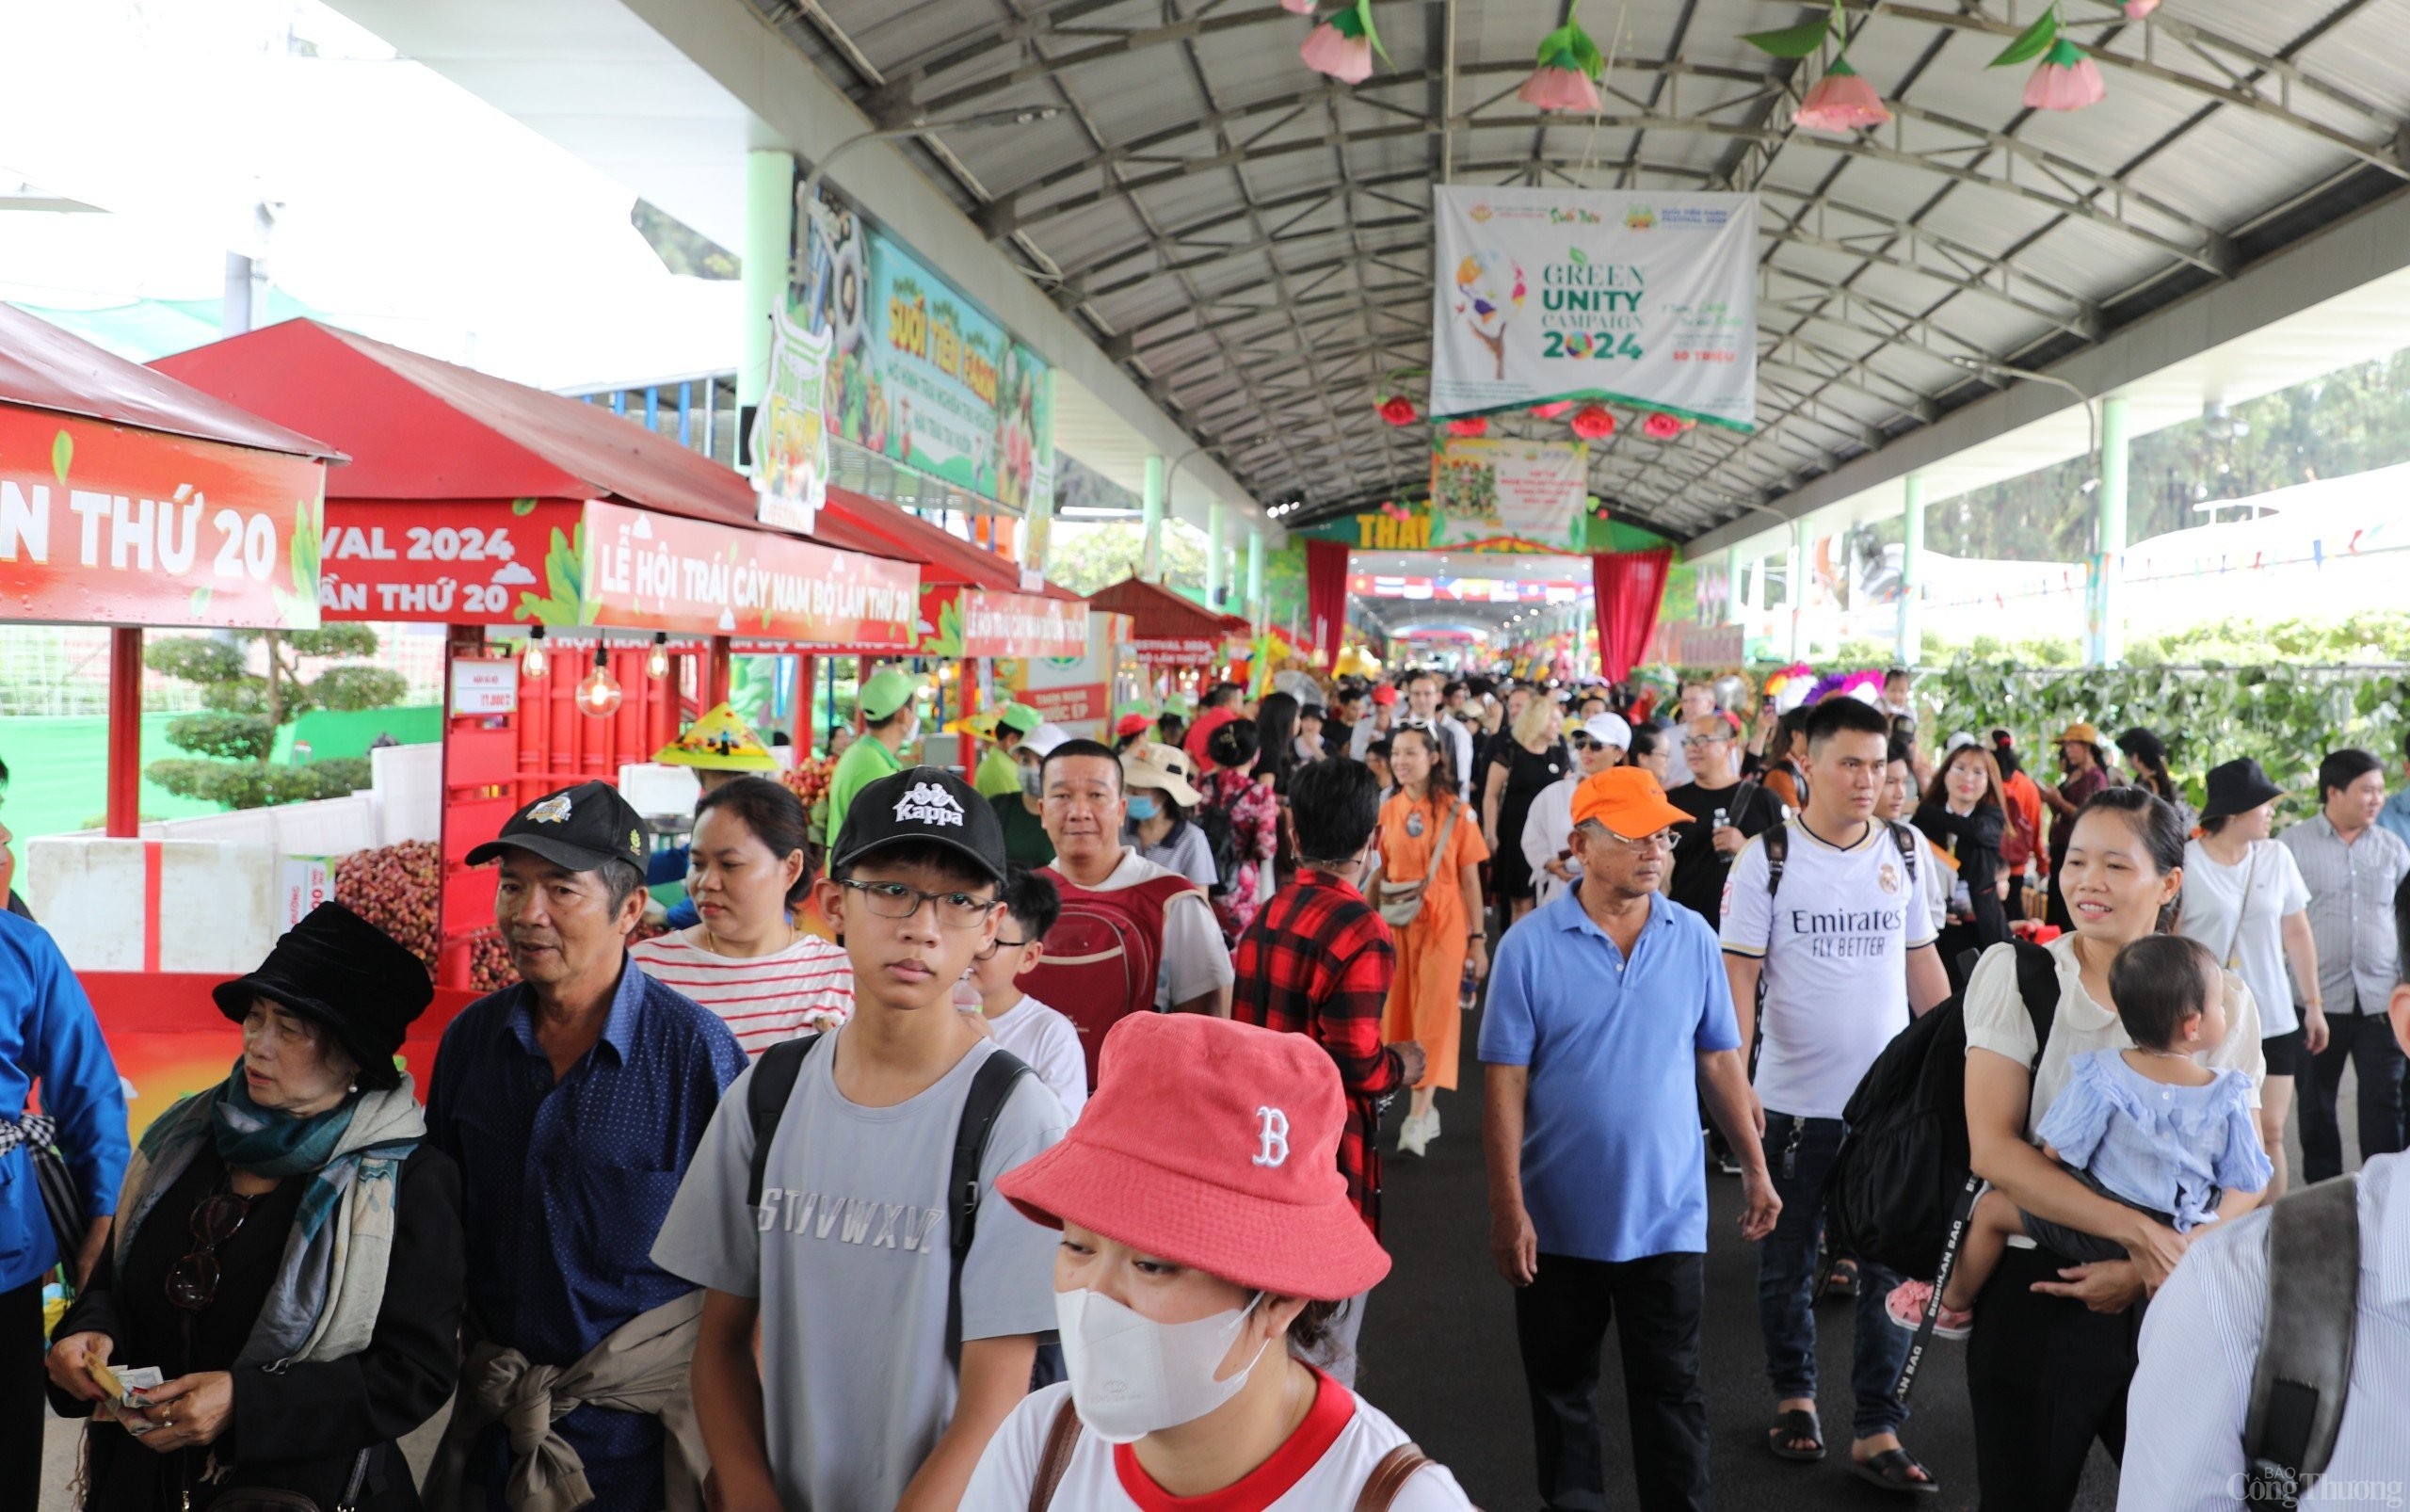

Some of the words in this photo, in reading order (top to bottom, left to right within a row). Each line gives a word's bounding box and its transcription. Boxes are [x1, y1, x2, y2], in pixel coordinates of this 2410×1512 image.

[1544, 264, 1646, 286] GREEN
[1543, 290, 1644, 312] UNITY
[1542, 314, 1644, 330] CAMPAIGN
[1542, 330, 1644, 360] 2024
[71, 483, 204, 575] THỨ
[213, 508, 278, 583] 20
[406, 526, 515, 561] 2024
[601, 524, 631, 595] LỄ
[636, 540, 678, 611] HỘI
[683, 552, 730, 605] TRÁI
[733, 558, 773, 610] CÂY
[772, 572, 811, 613] NAM
[813, 574, 835, 626] BỘ
[895, 590, 910, 622] 20
[376, 576, 458, 613] THỨ
[462, 583, 508, 613] 20
[894, 803, 964, 827] Kappa
[1792, 908, 1902, 934] Emirates
[1812, 937, 1833, 957] FLY
[1838, 936, 1884, 957] BETTER
[1252, 1105, 1291, 1167] B
[1947, 1219, 1963, 1250] BAG
[1897, 1375, 1911, 1400] AN
[1906, 1344, 1923, 1374] BAG
